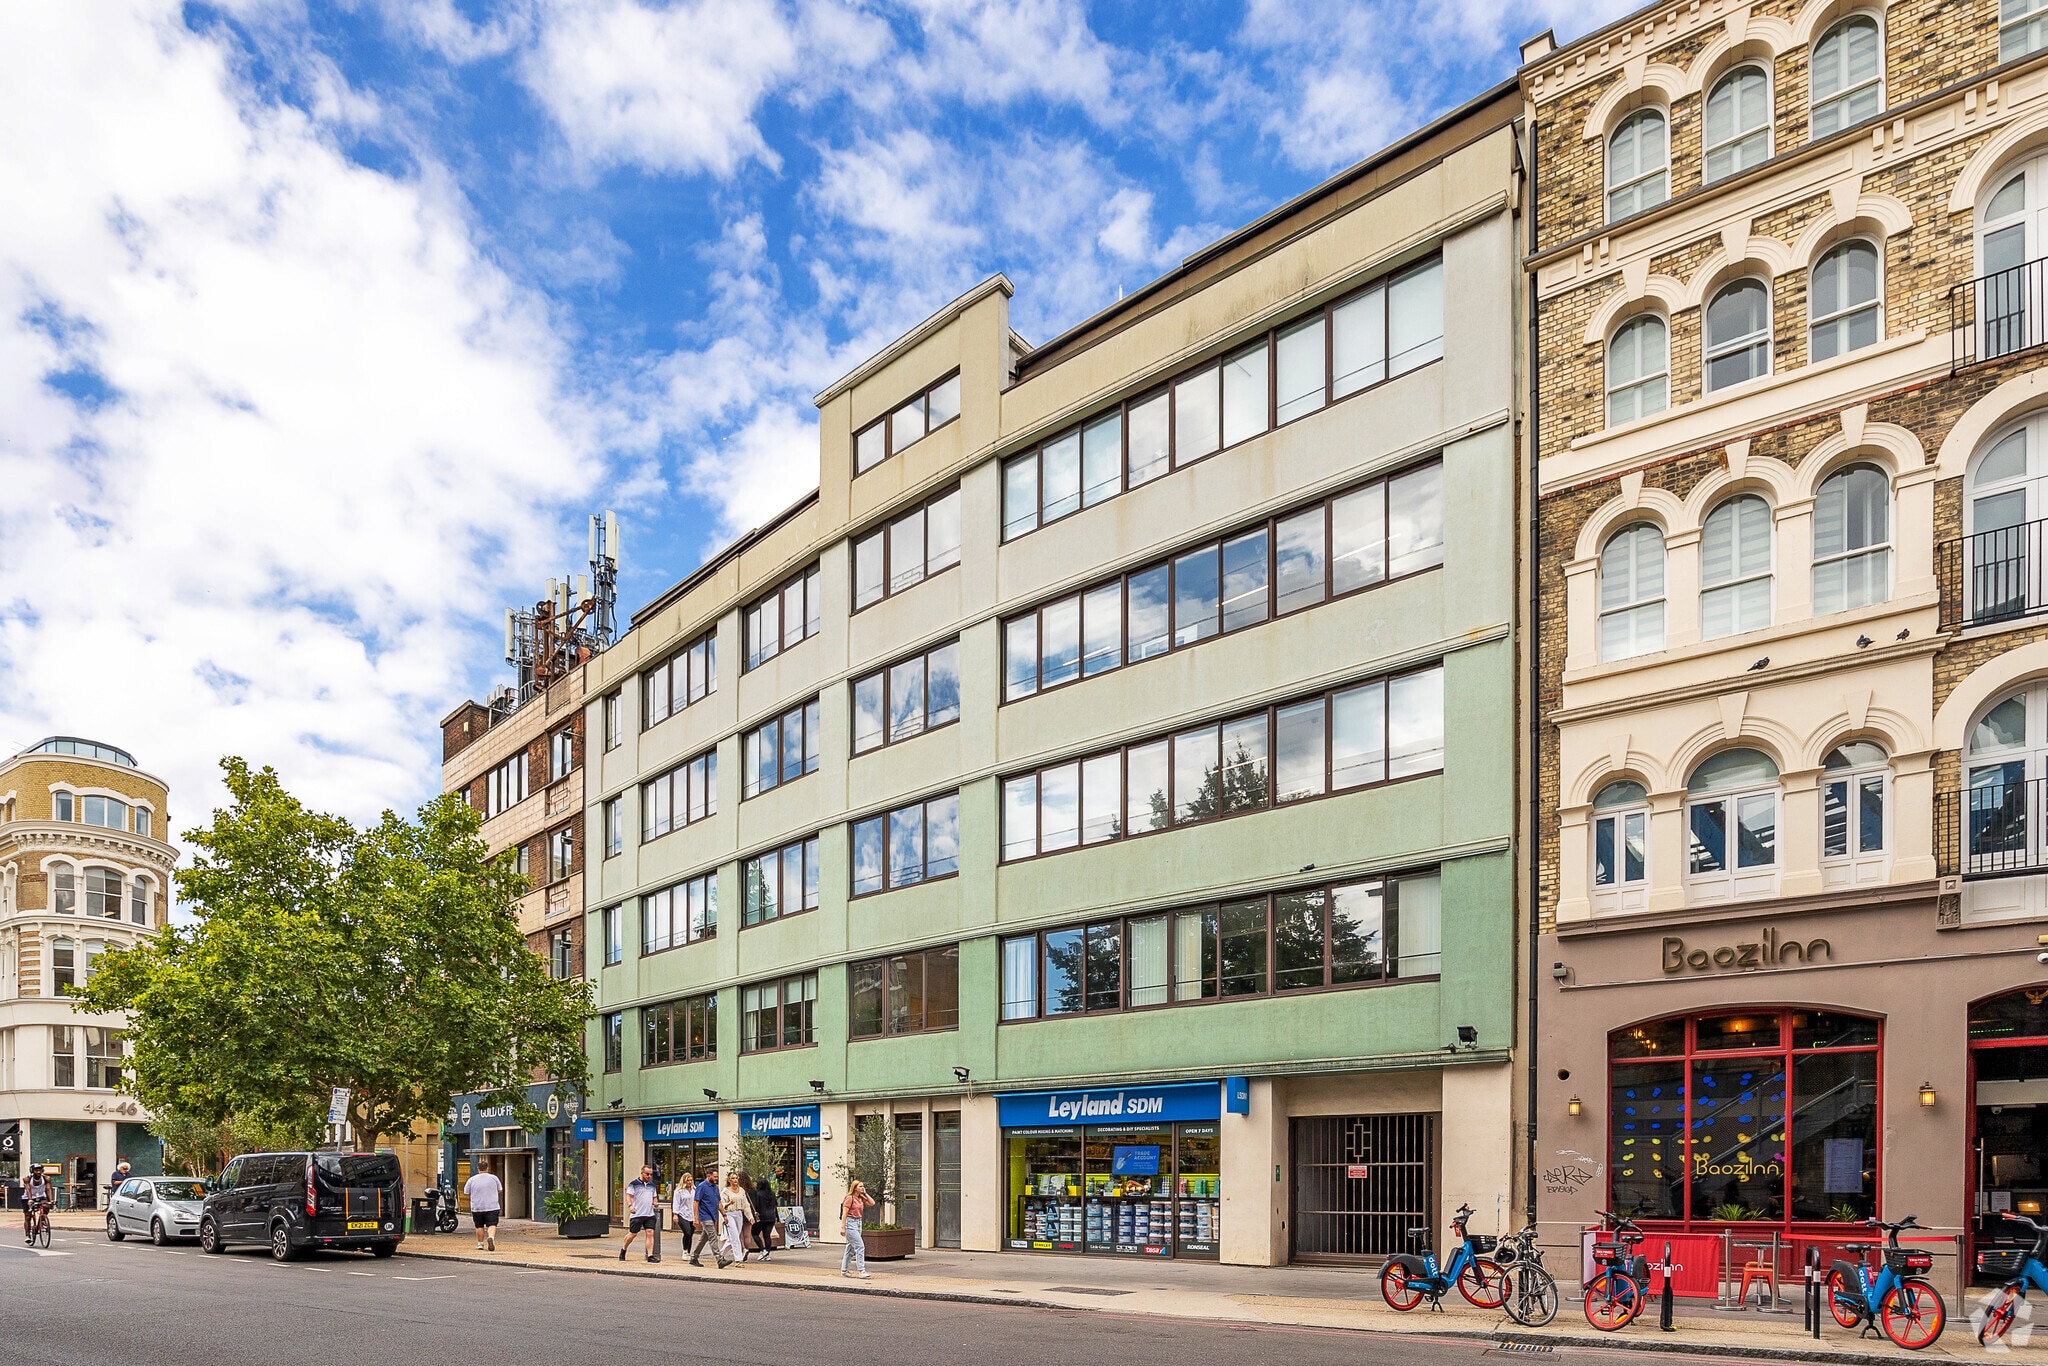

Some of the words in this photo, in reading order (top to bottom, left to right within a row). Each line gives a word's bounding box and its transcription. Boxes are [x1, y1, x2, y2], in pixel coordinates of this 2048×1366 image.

[83, 1100, 138, 1116] 44-46
[1048, 1092, 1124, 1120] Leyland
[1126, 1097, 1163, 1114] SDM
[657, 1118, 689, 1136] Leyland
[690, 1121, 705, 1133] SDM
[751, 1111, 791, 1132] Leyland
[792, 1115, 811, 1128] SDM
[1428, 1256, 1438, 1276] dott
[1858, 1269, 1867, 1293] dott
